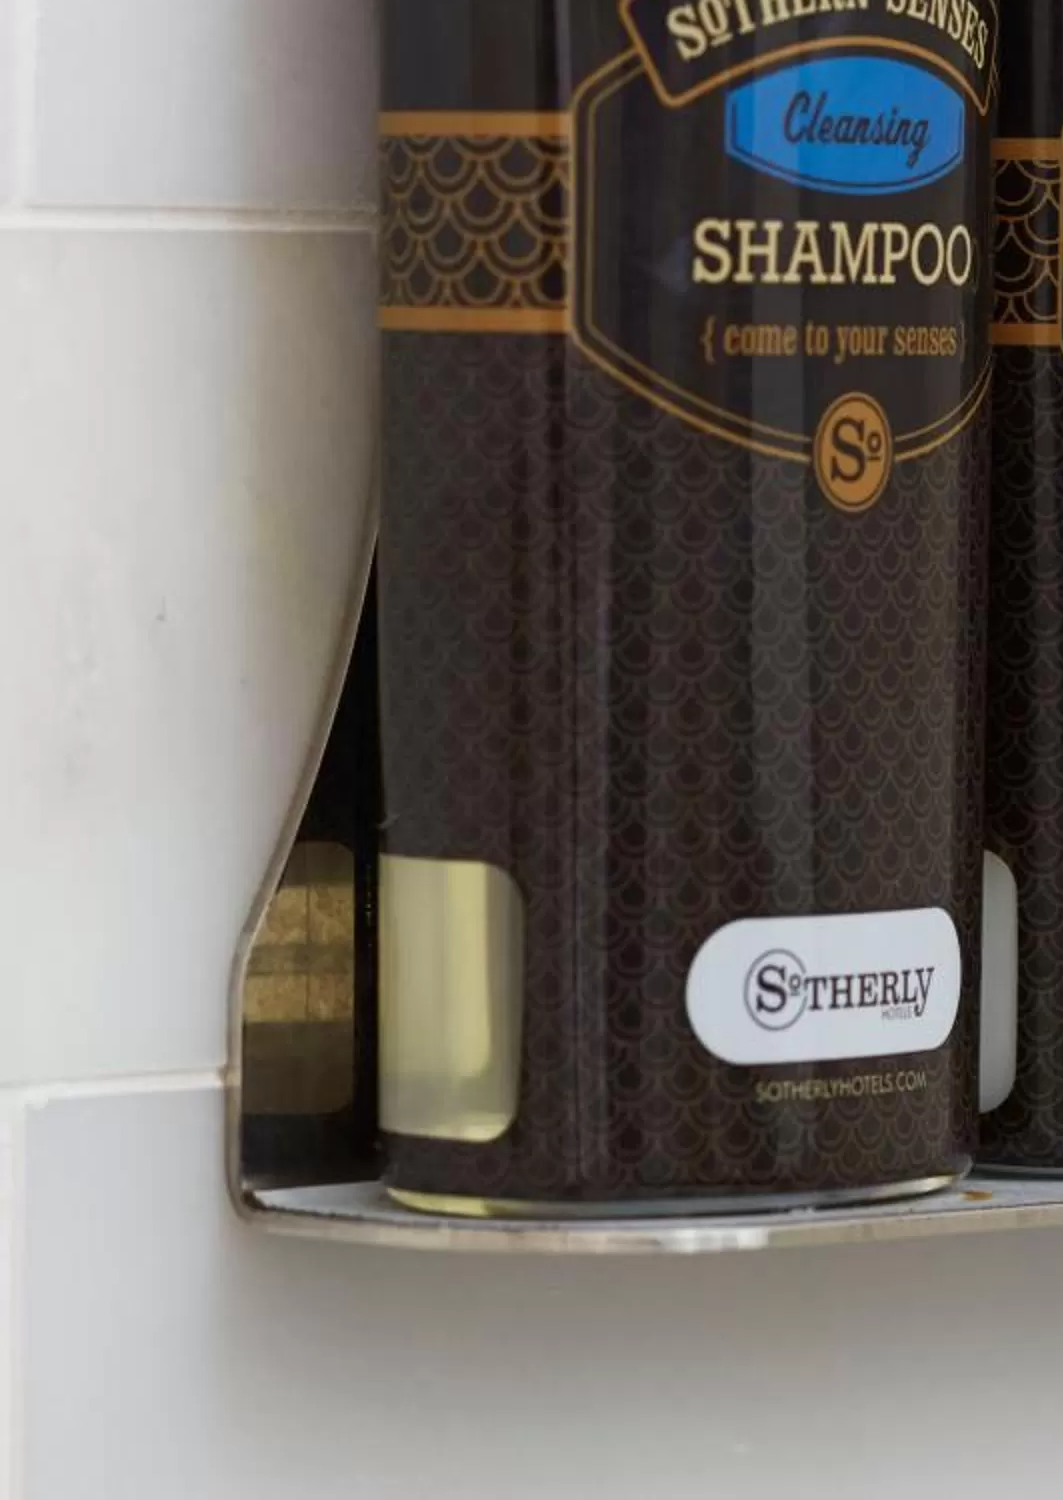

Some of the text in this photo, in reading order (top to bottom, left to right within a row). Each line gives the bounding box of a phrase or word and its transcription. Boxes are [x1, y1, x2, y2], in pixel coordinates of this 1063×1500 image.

[784, 91, 929, 168] Cleansing
[692, 218, 973, 286] SHAMPOO
[806, 319, 829, 356] to
[834, 324, 887, 365] your
